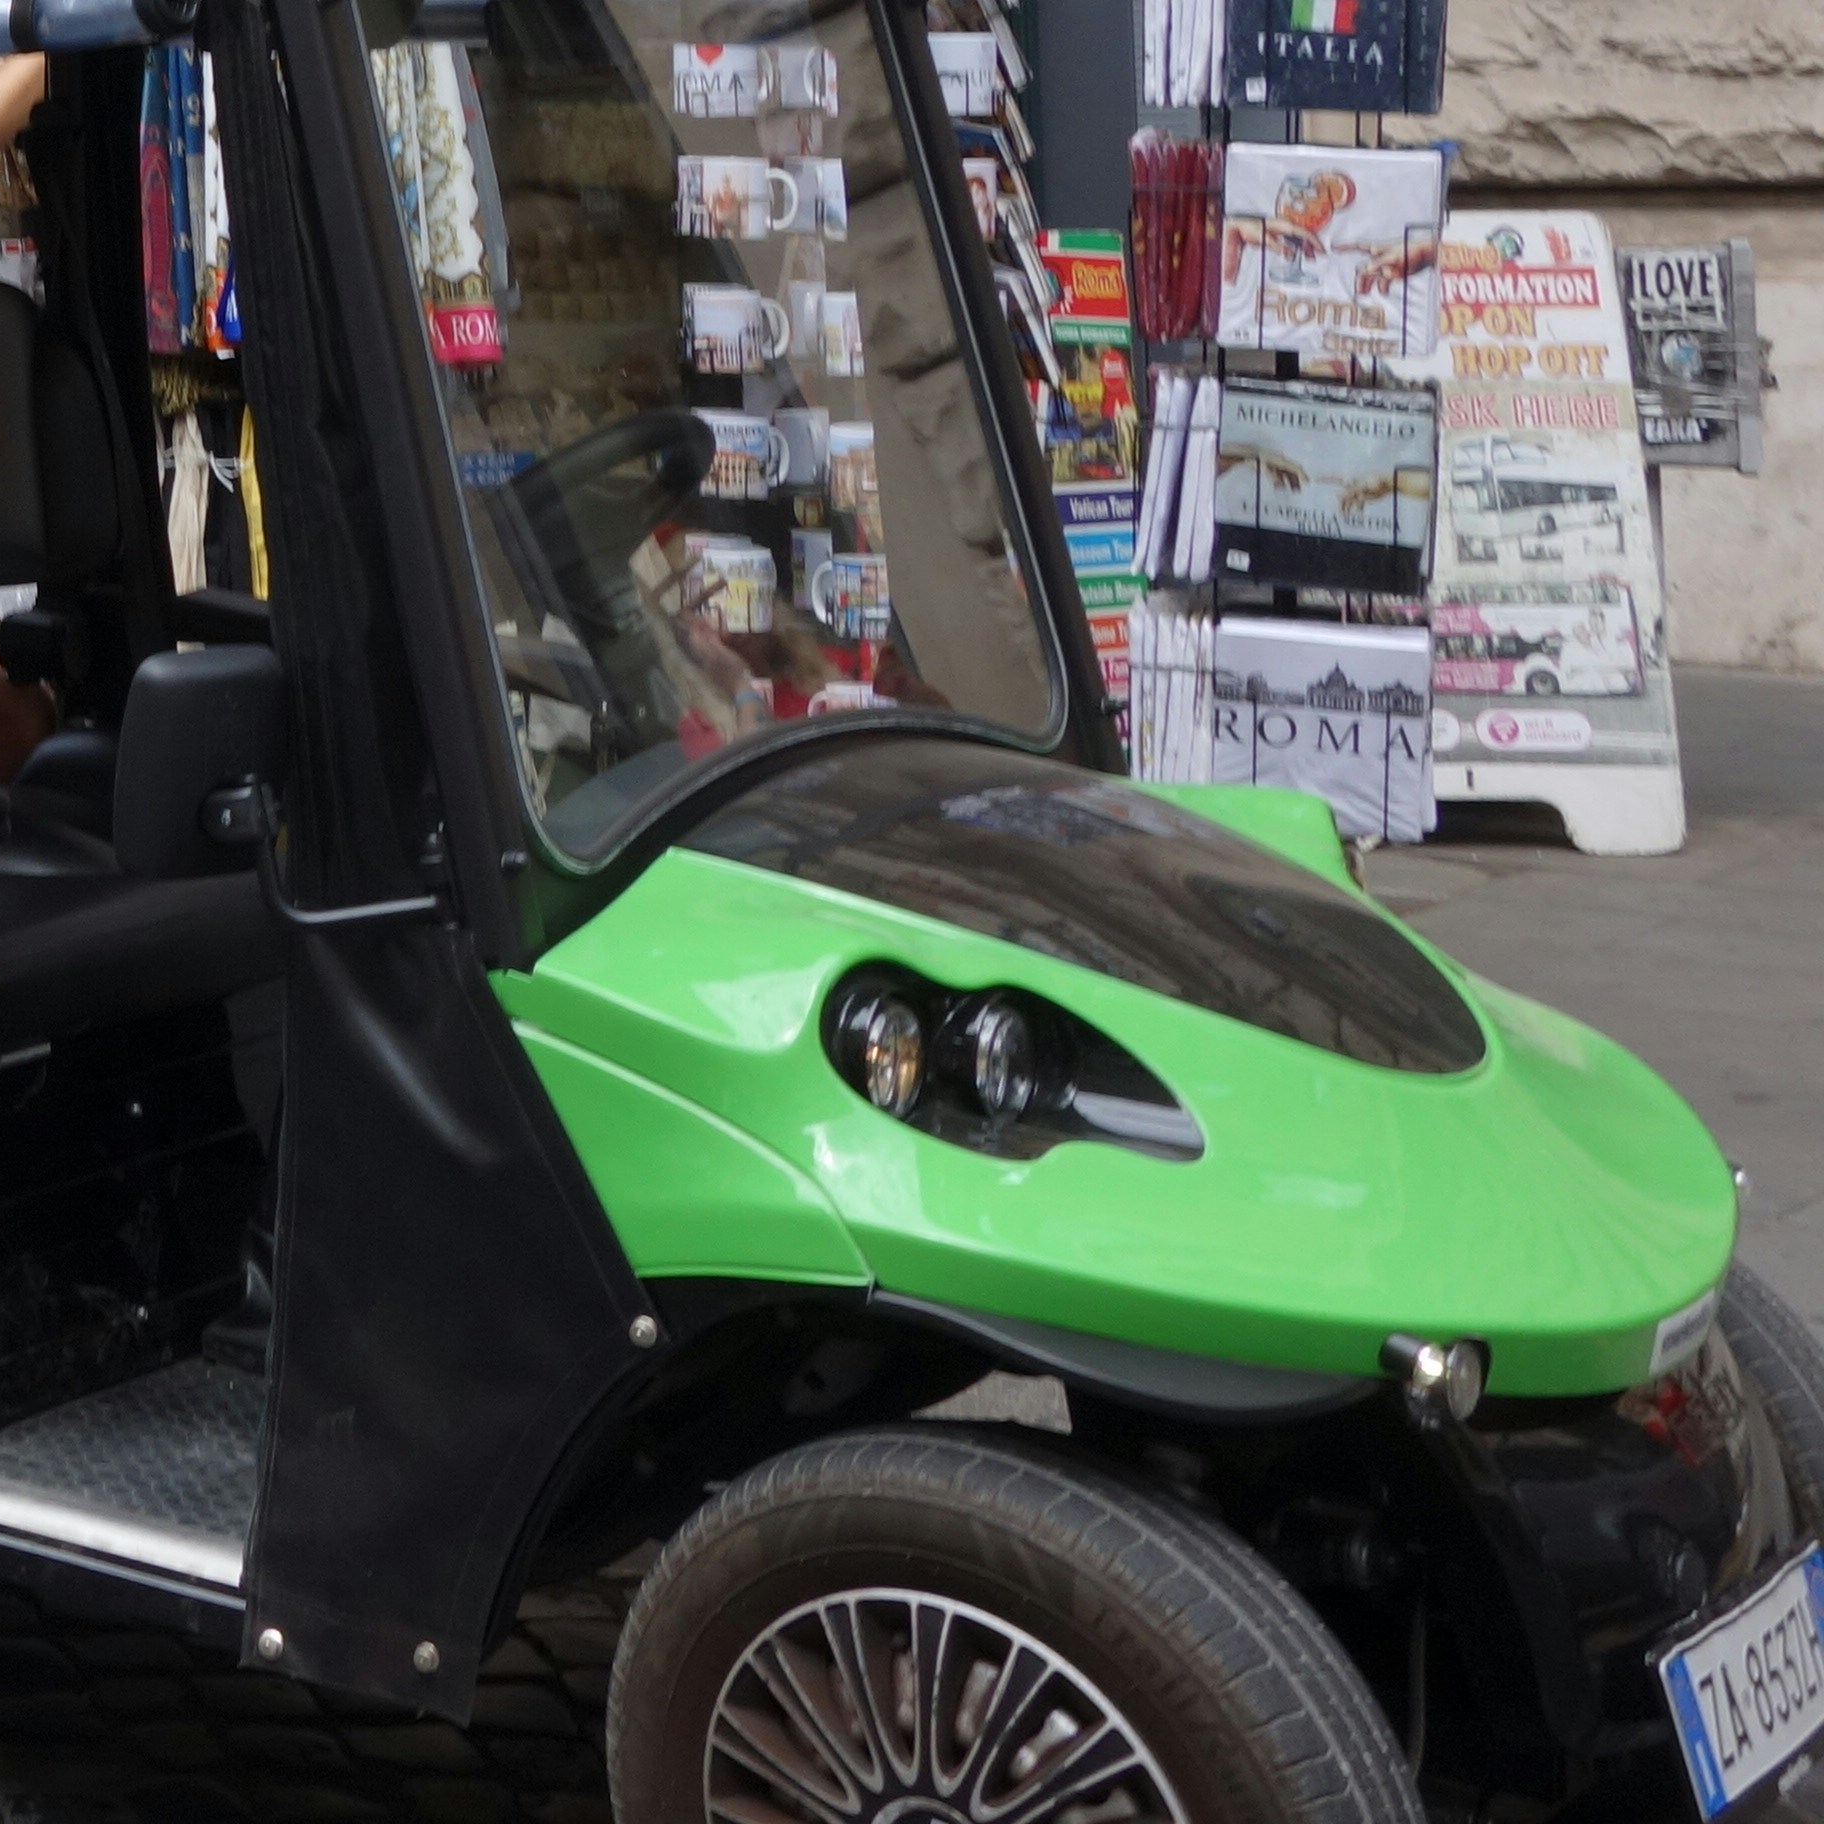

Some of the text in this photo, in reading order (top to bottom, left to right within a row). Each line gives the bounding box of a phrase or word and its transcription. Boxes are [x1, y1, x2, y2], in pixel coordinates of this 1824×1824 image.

[1257, 31, 1385, 67] ITALIA
[1440, 271, 1594, 305] FORMATION
[1254, 287, 1387, 330] Roma
[1482, 304, 1536, 338] ON
[1450, 343, 1609, 380] HOP OFF
[1237, 401, 1417, 441] MICHELANGELO
[1512, 393, 1620, 430] HERE
[1212, 705, 1417, 761] ROMA
